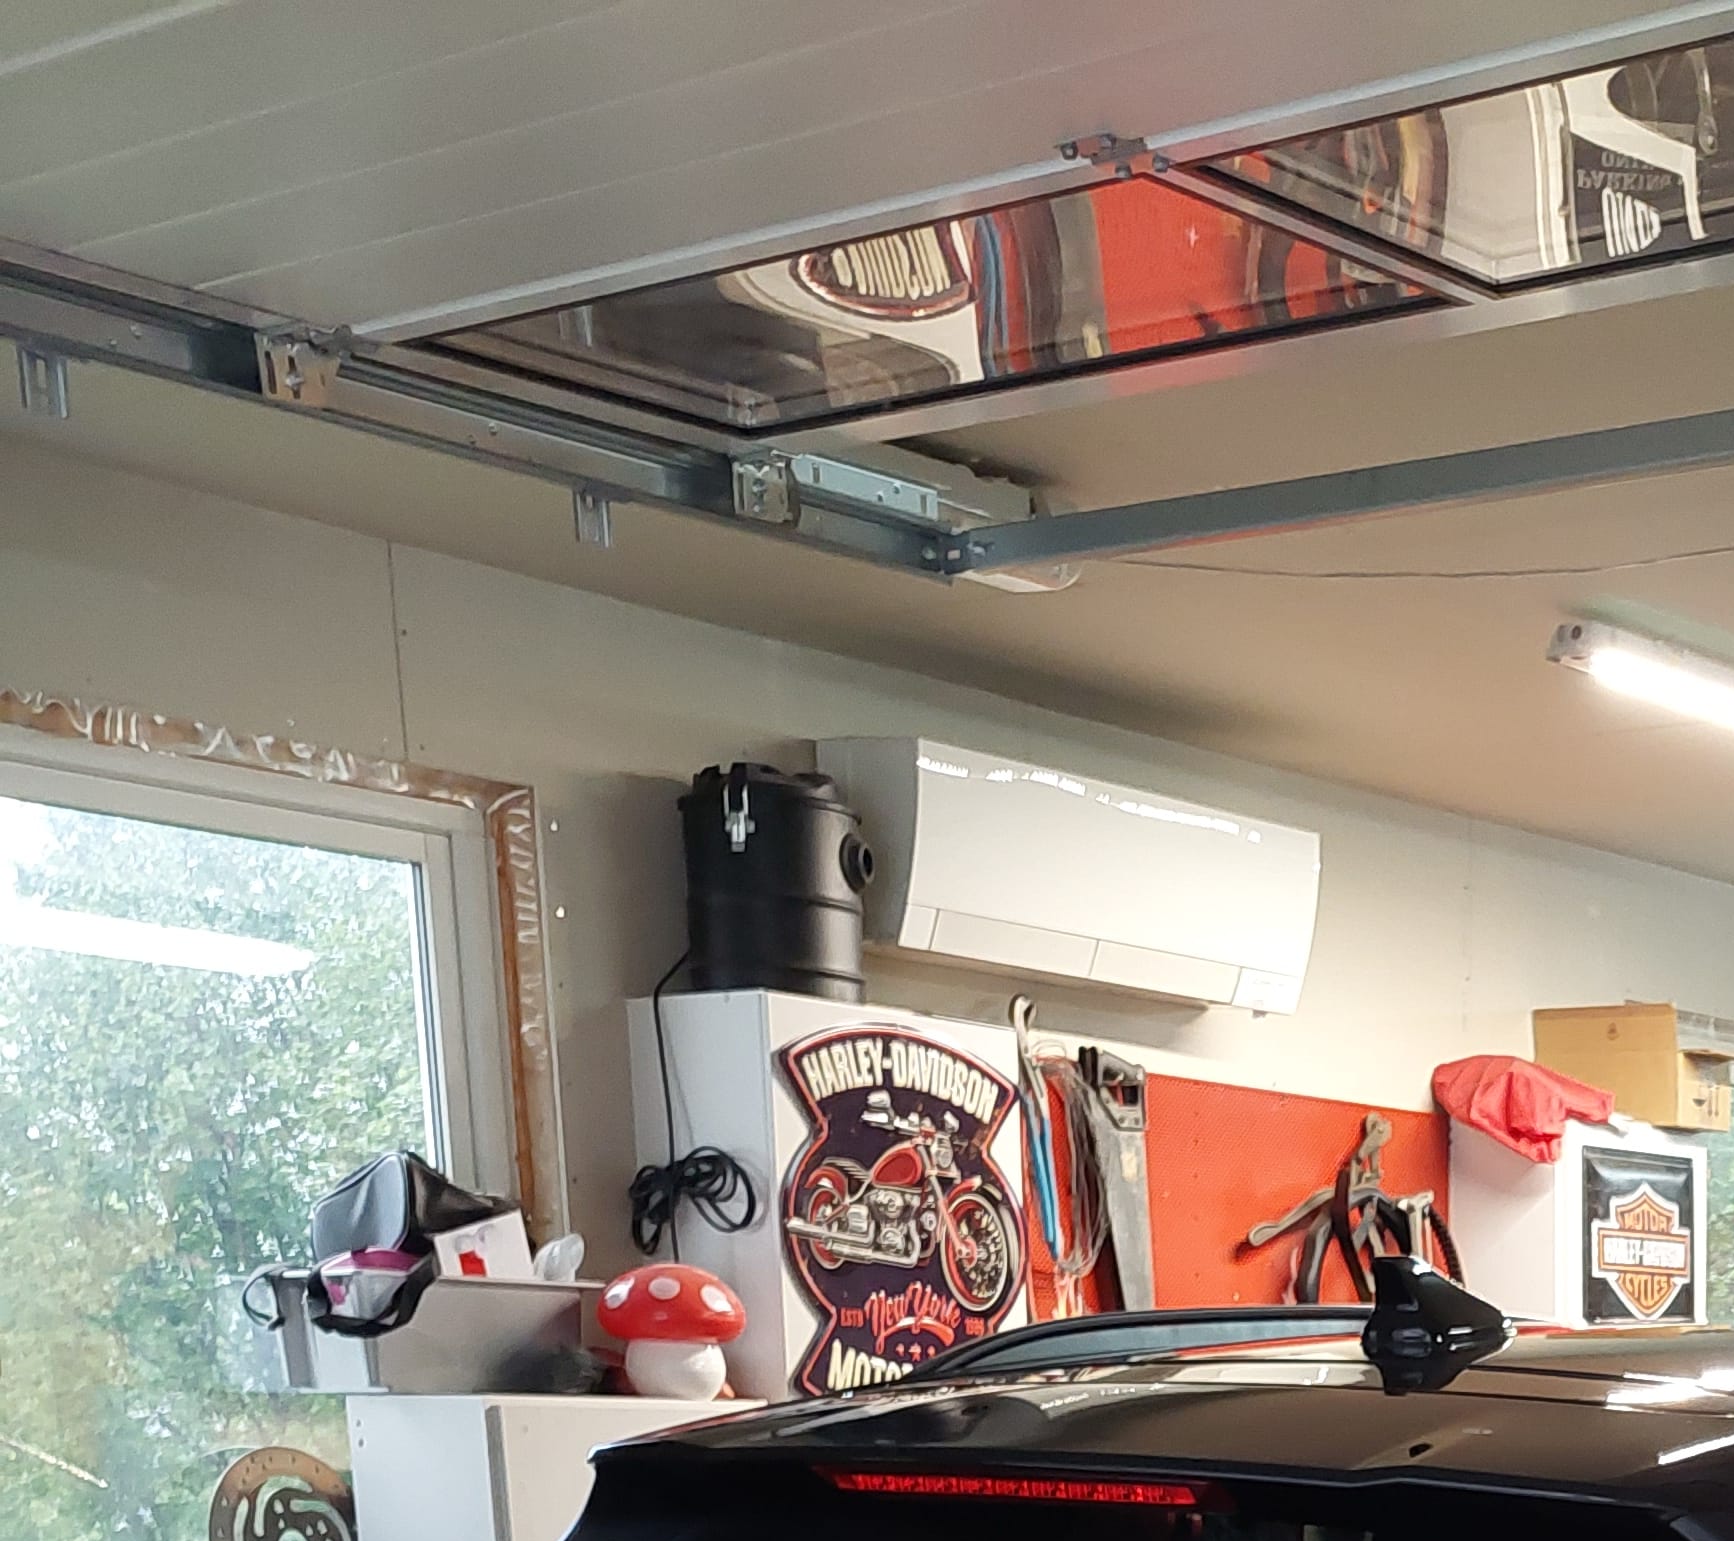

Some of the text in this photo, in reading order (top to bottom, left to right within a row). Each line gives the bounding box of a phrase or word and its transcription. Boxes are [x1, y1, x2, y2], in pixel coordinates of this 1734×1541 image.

[800, 1036, 999, 1125] HARLEY-DAVIDSON
[1622, 1208, 1670, 1233] MOTOR
[1624, 1273, 1670, 1306] CYCLES
